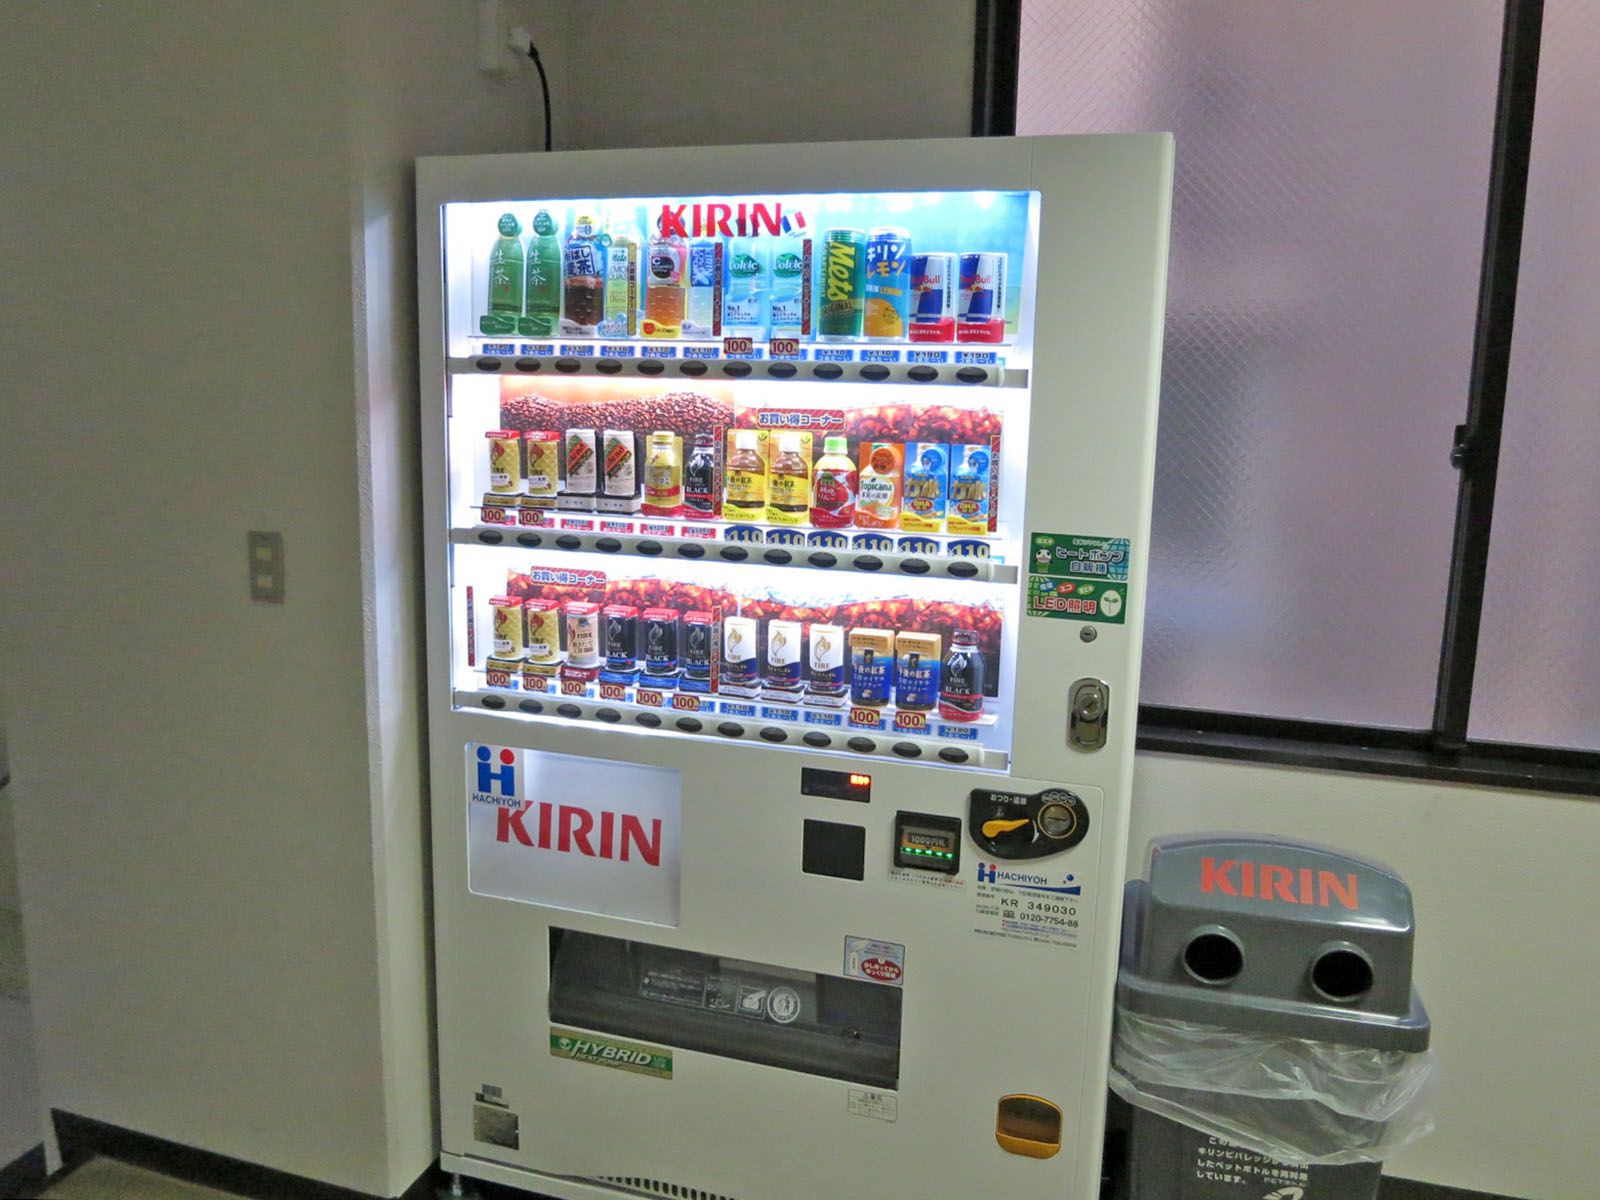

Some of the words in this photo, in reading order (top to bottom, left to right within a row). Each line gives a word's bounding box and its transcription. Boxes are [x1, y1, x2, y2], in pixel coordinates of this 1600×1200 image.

[662, 203, 782, 238] KIRIN
[866, 243, 906, 262] キリン
[496, 249, 510, 285] 生茶
[531, 249, 546, 285] 生茶
[827, 240, 856, 302] Mets
[866, 260, 906, 278] レモン
[924, 275, 941, 284] Bull
[975, 275, 992, 284] Bull
[726, 341, 747, 352] 100
[772, 342, 793, 353] 100
[759, 413, 842, 426] お買い得コーナー
[861, 480, 893, 492] Tropicana
[483, 510, 501, 521] 100
[520, 512, 539, 523] 100
[1056, 546, 1124, 564] ヒートポンプ
[1070, 560, 1107, 575] 自販機
[532, 571, 606, 585] お買い得コーナー
[1033, 595, 1097, 614] LED照明
[488, 673, 507, 683] 100
[525, 679, 543, 689] 100
[563, 683, 581, 693] 100
[601, 686, 621, 697] 100
[638, 692, 658, 704] 100
[675, 697, 695, 708] 100
[853, 712, 874, 723] 100
[899, 714, 920, 726] 100
[472, 793, 522, 808] HACHIYOH
[496, 800, 662, 867] KIRIN
[997, 871, 1048, 886] HACHIYOH
[1200, 857, 1360, 911] KIRIN
[1001, 898, 1019, 908] KR
[1027, 901, 1077, 916] 349030
[1020, 912, 1080, 929] 0120-7754-88
[571, 1040, 652, 1065] HYBRID
[1196, 1170, 1247, 1185] しています。
